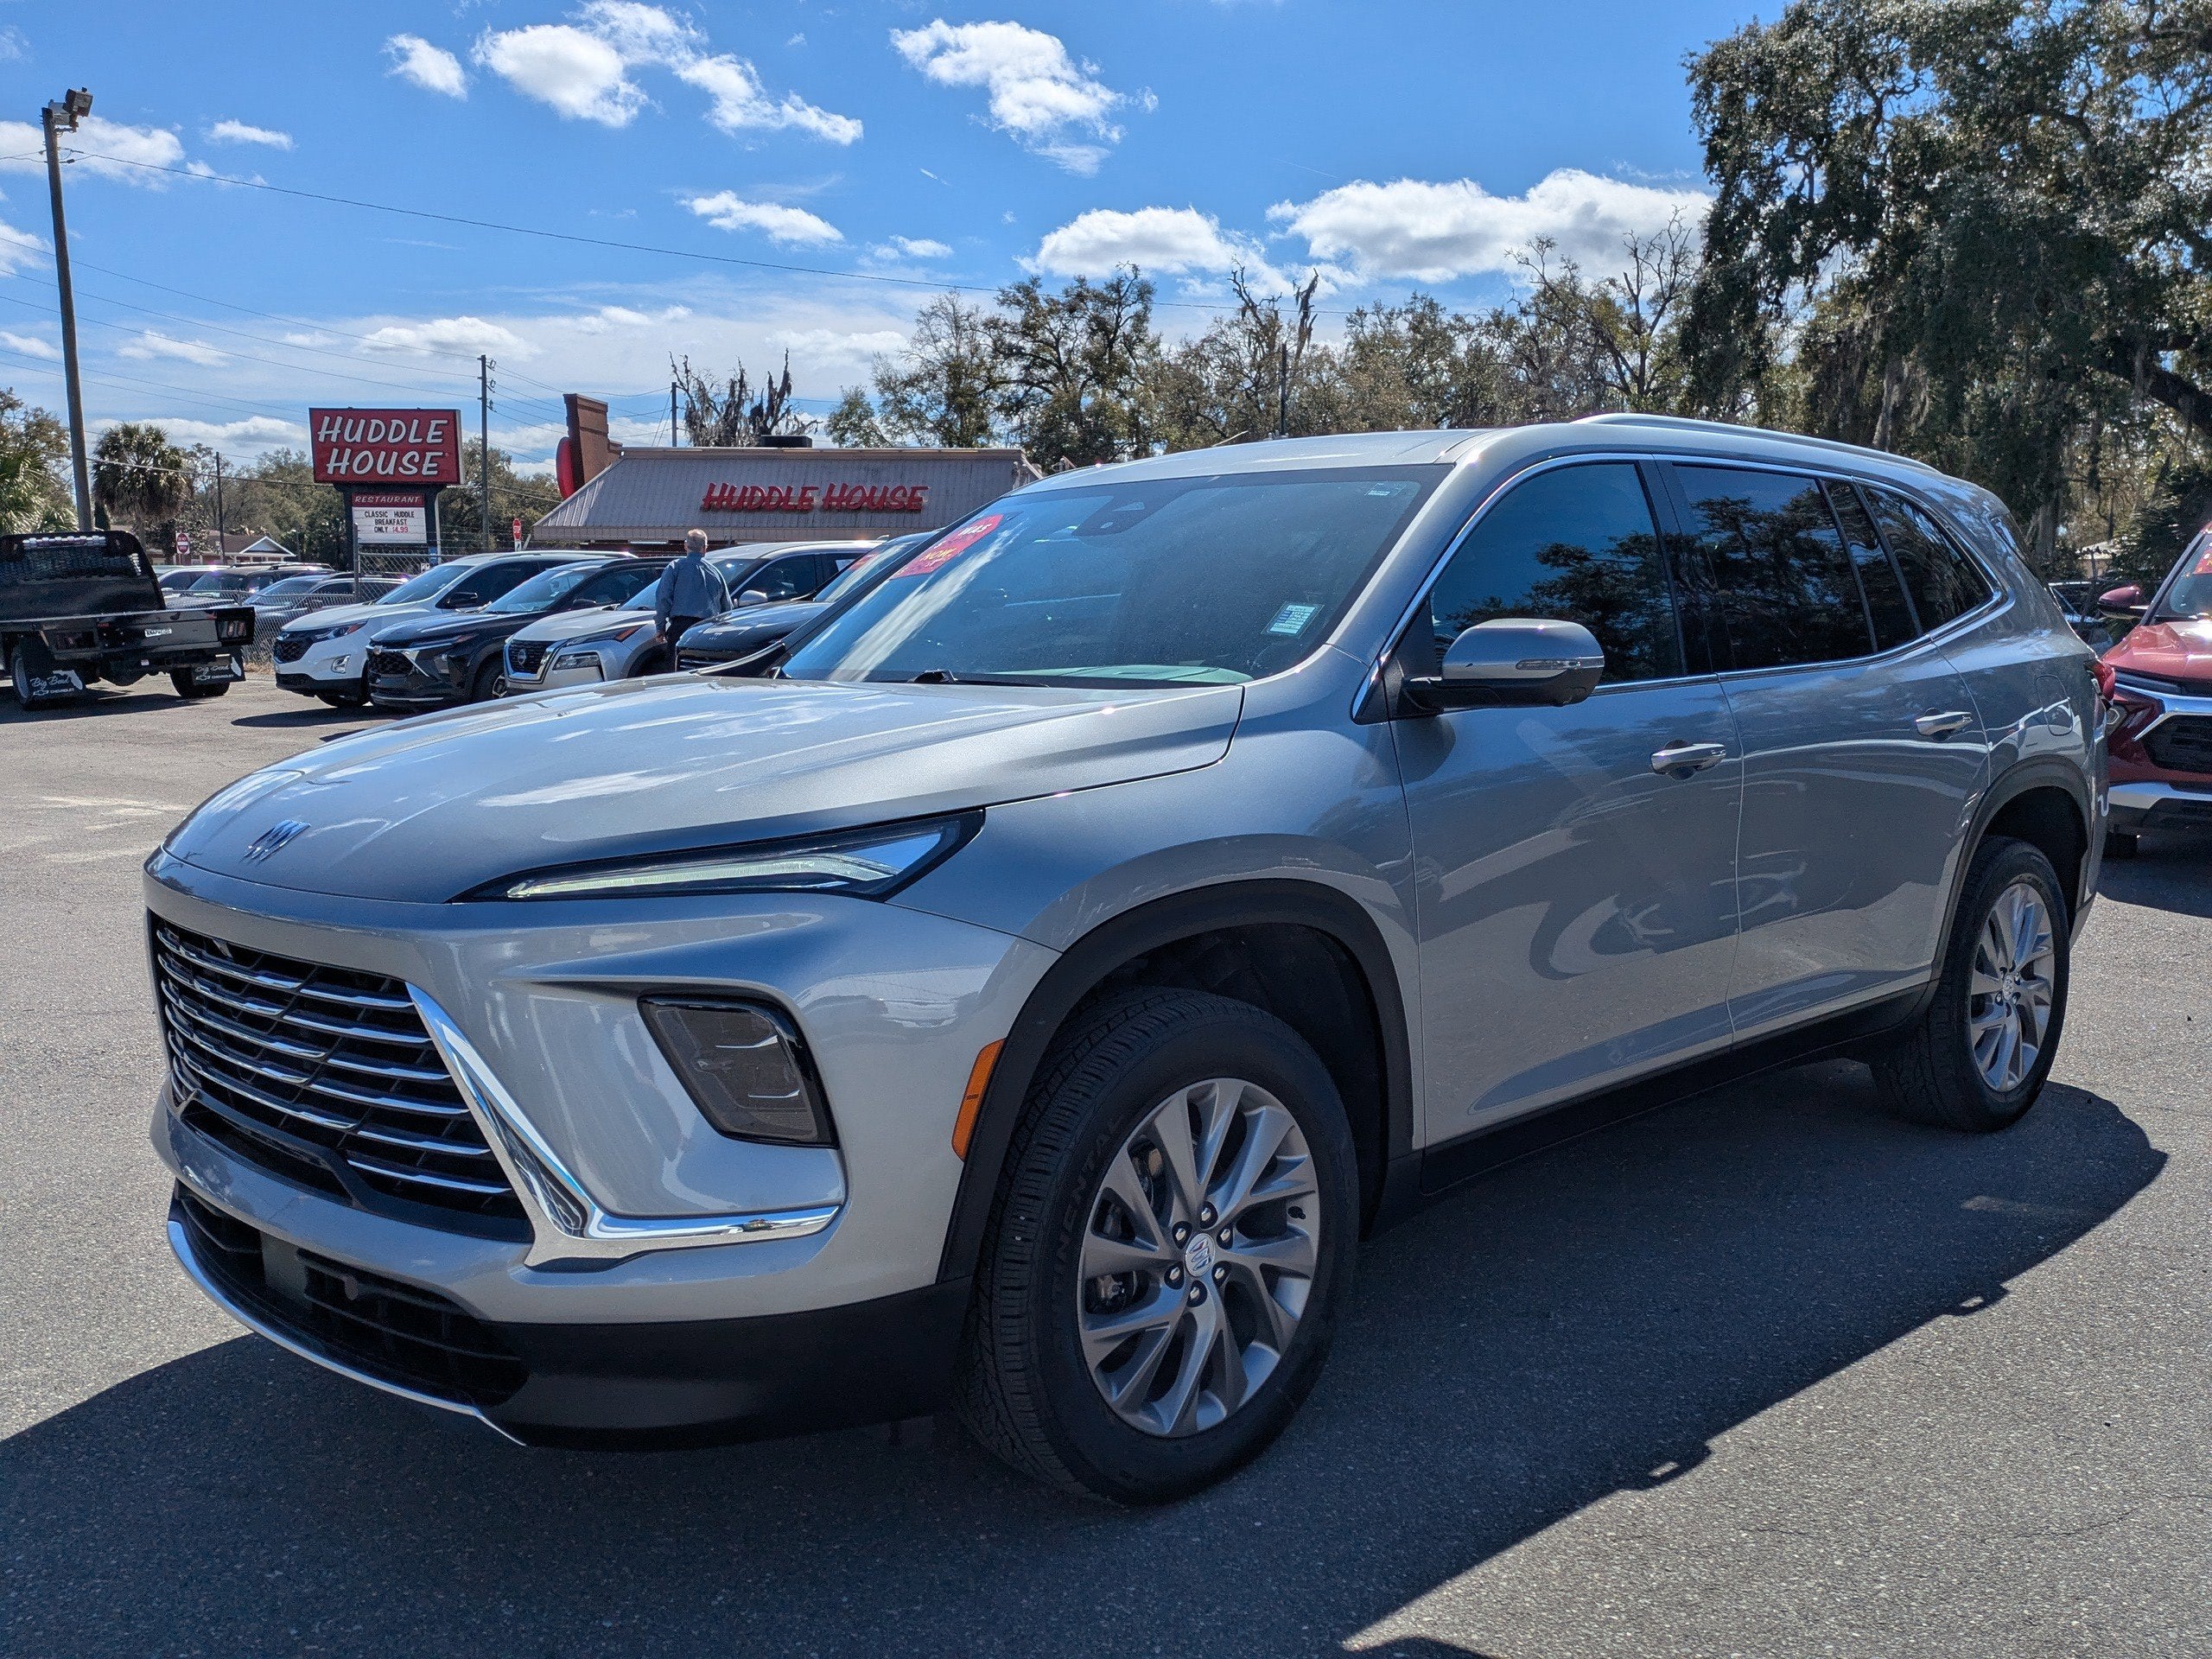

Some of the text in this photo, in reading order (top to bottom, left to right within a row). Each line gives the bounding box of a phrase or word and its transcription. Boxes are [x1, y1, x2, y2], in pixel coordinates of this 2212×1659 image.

[317, 416, 448, 444] HUDDLE
[326, 448, 443, 475] HOUSE
[702, 482, 931, 512] HUDDLE HOUSE
[29, 677, 48, 690] Big
